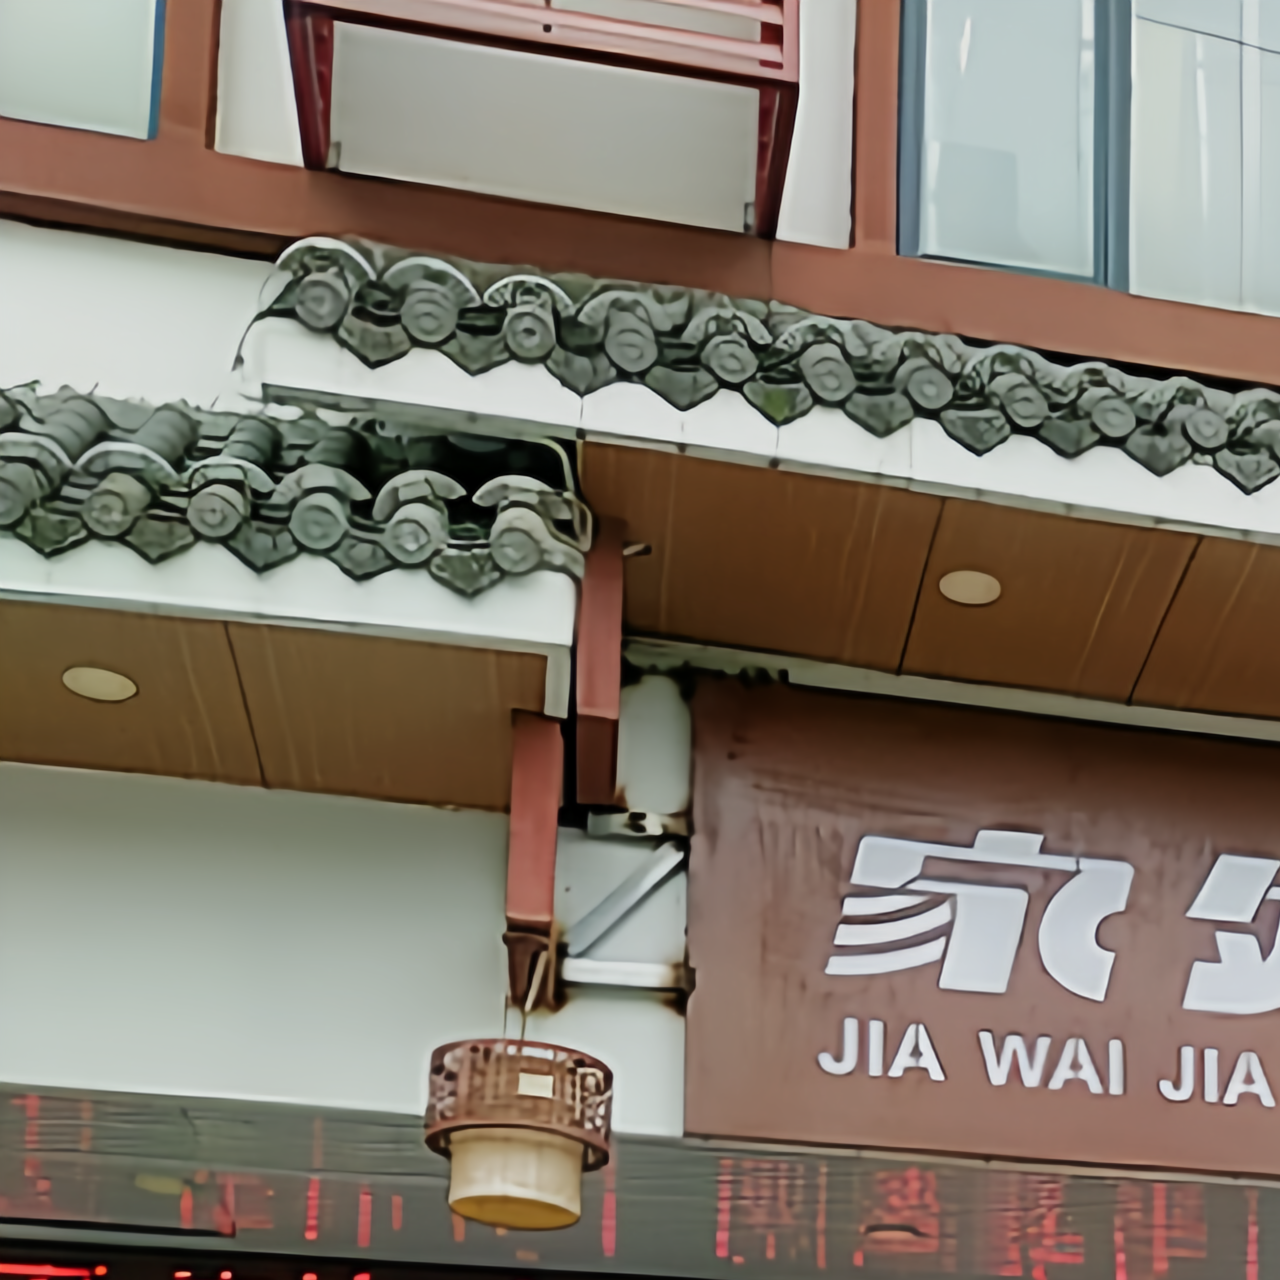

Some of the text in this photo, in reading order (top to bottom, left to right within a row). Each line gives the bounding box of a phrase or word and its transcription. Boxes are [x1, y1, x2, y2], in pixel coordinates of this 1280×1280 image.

[817, 1017, 1276, 1108] JIA WAI JIA
